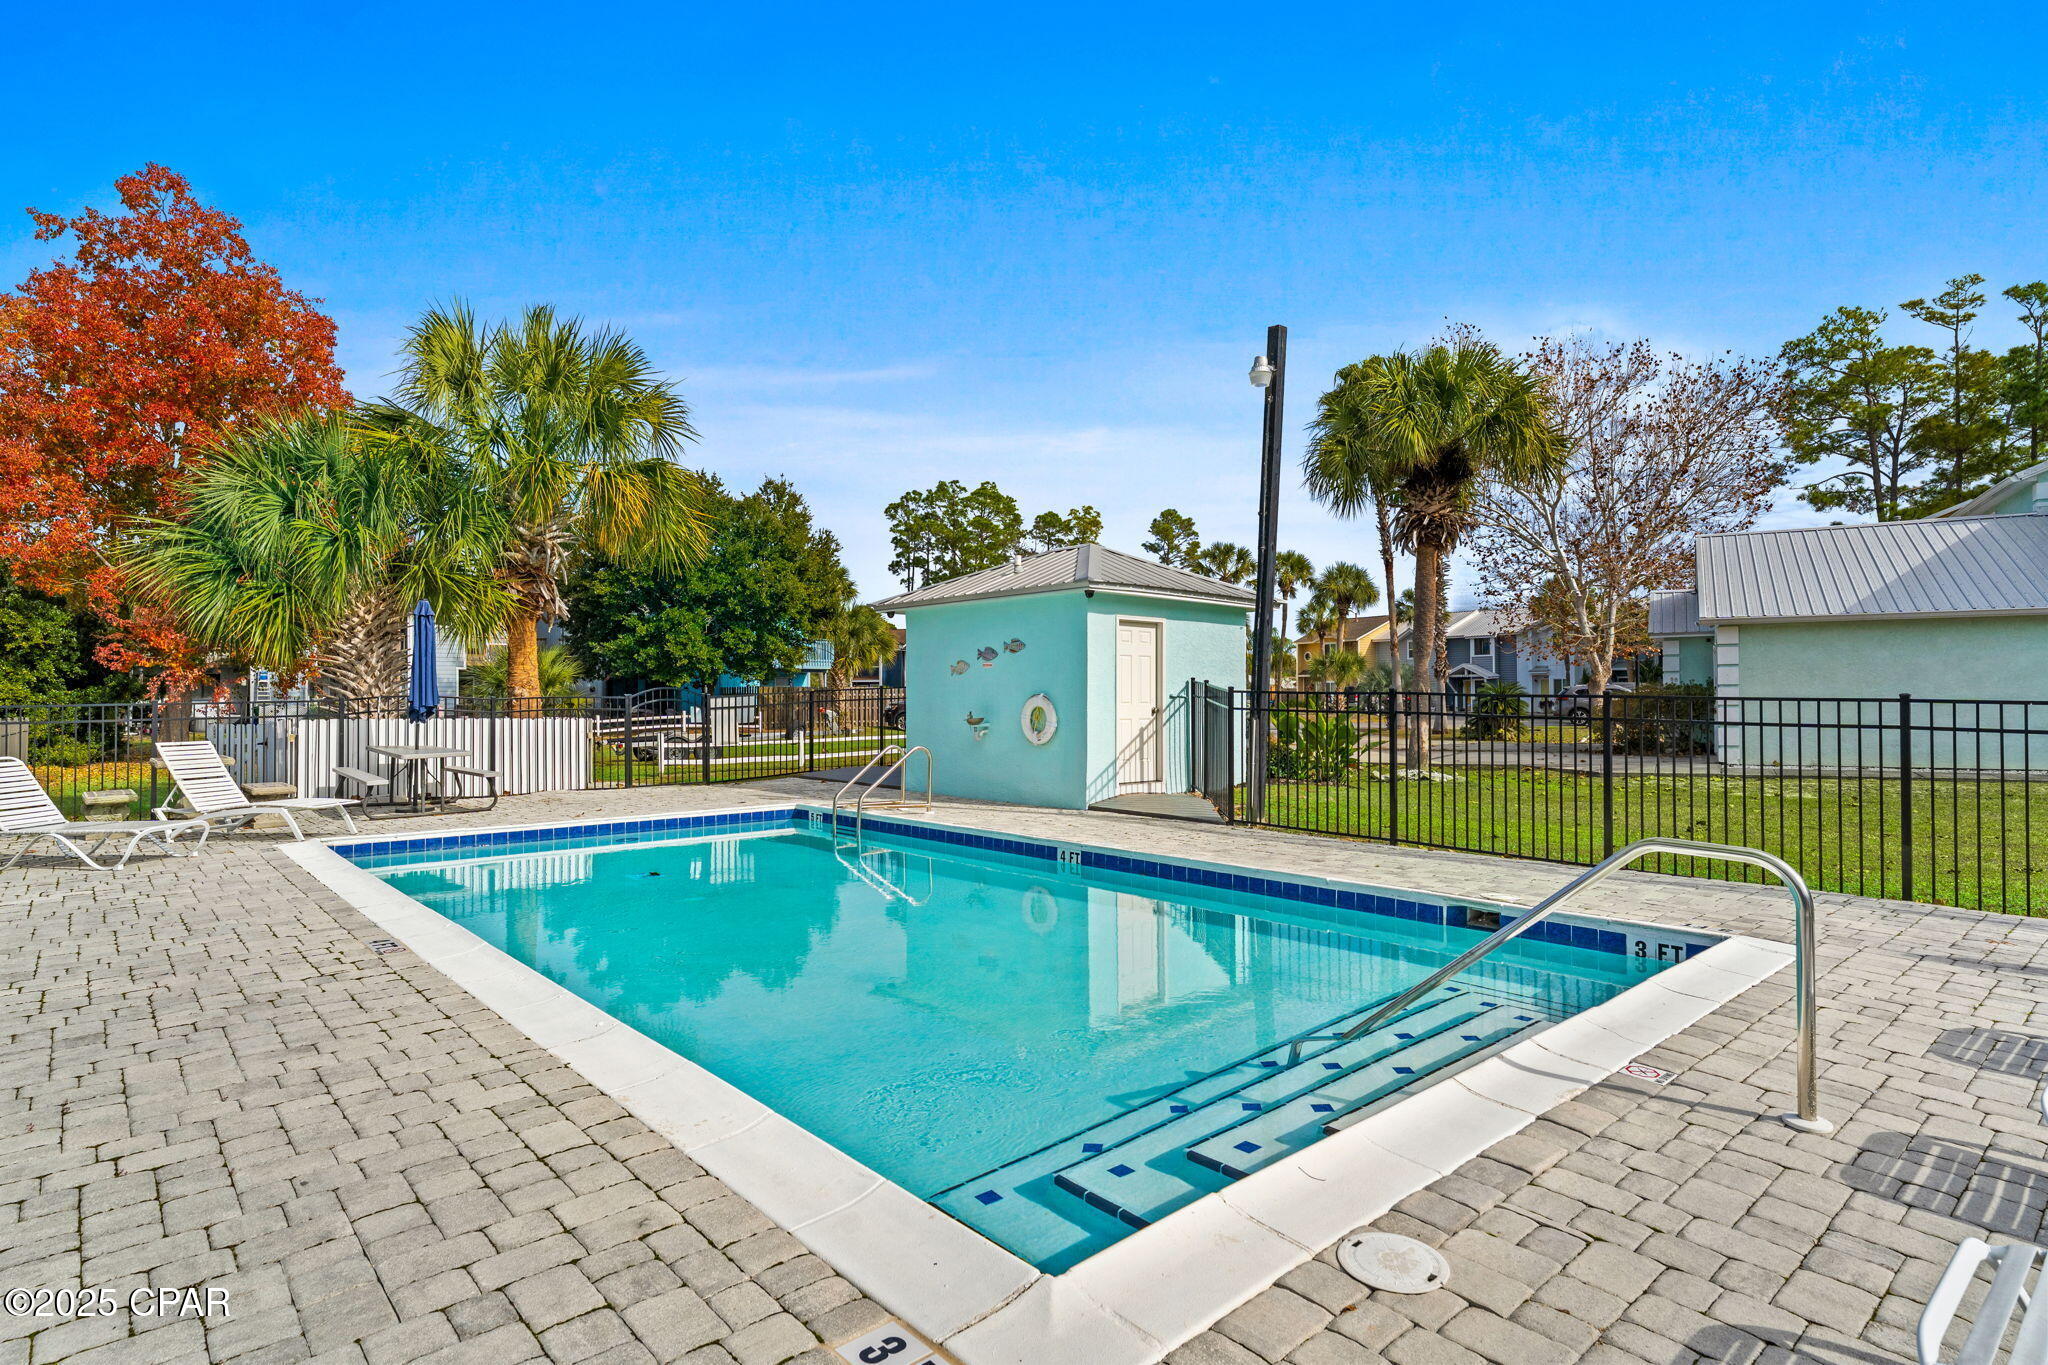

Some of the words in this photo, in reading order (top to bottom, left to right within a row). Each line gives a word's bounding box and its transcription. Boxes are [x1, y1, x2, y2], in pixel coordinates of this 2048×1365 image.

[1060, 850, 1066, 863] 4
[1070, 851, 1080, 865] FT
[1635, 940, 1647, 958] 3
[1658, 943, 1683, 963] FT
[858, 1336, 907, 1364] 3
